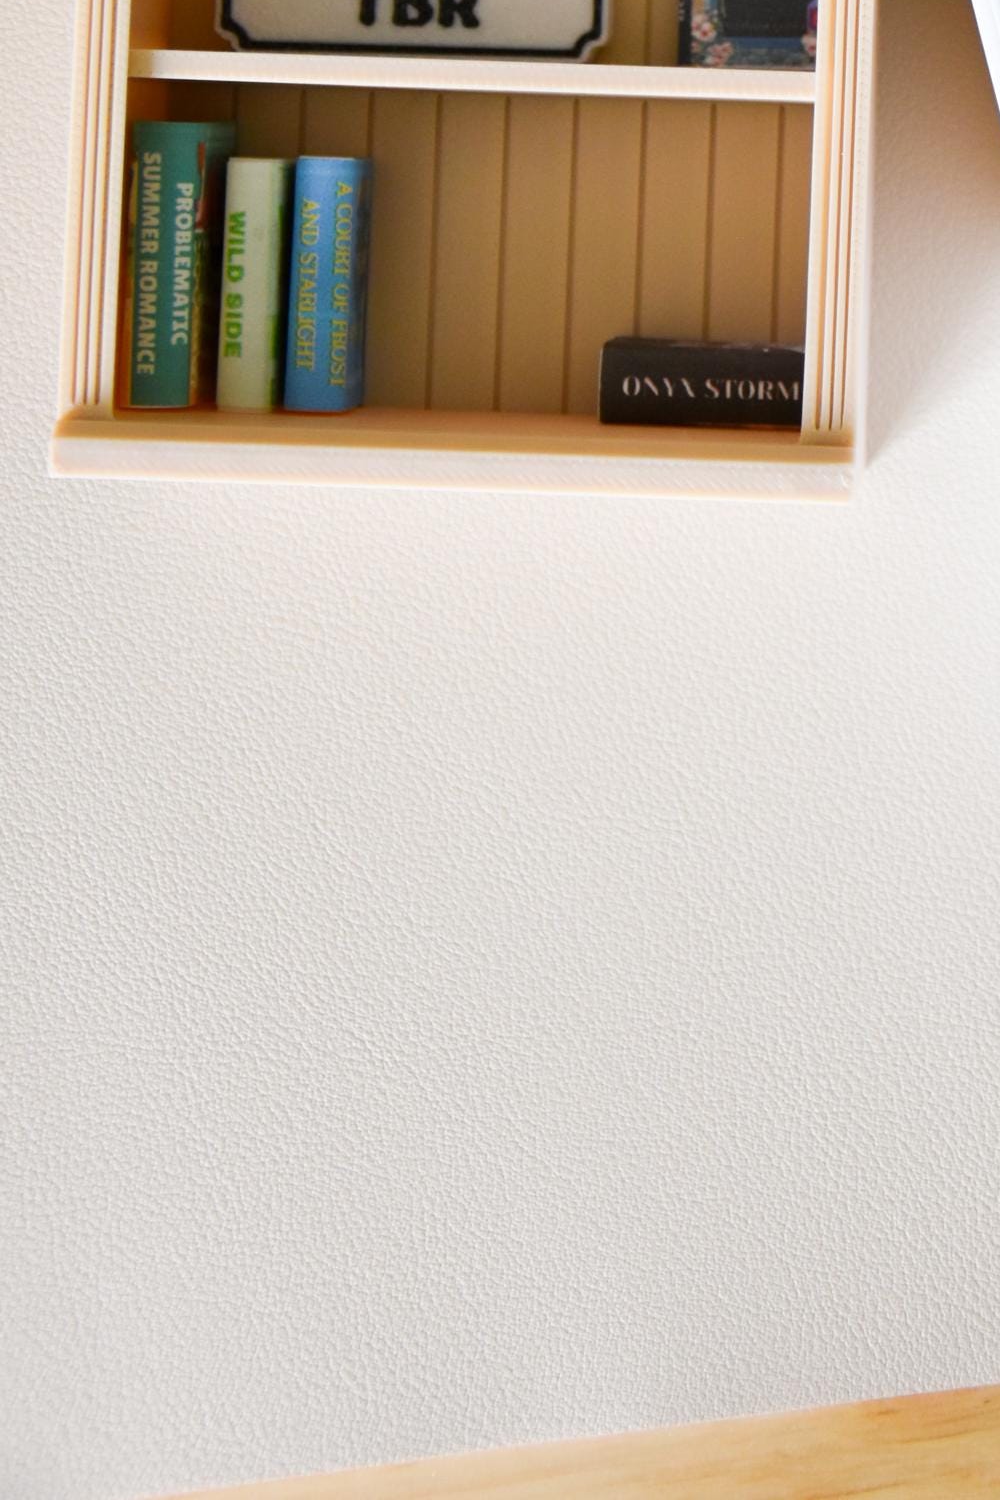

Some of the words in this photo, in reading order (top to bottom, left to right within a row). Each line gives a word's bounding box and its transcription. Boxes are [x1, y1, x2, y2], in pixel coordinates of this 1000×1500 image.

[140, 153, 162, 254] SUMMER
[302, 198, 321, 246] AND
[337, 181, 353, 197] A
[171, 182, 194, 345] PROBLEMATIC
[224, 211, 246, 283] WILD
[333, 203, 352, 278] COURT
[137, 260, 158, 375] ROMANCE
[223, 293, 243, 358] SIDE
[296, 252, 318, 371] STARLIGHT
[332, 286, 348, 313] OF
[330, 318, 348, 387] FROST
[622, 376, 695, 398] ONYX
[704, 378, 799, 400] STORM
